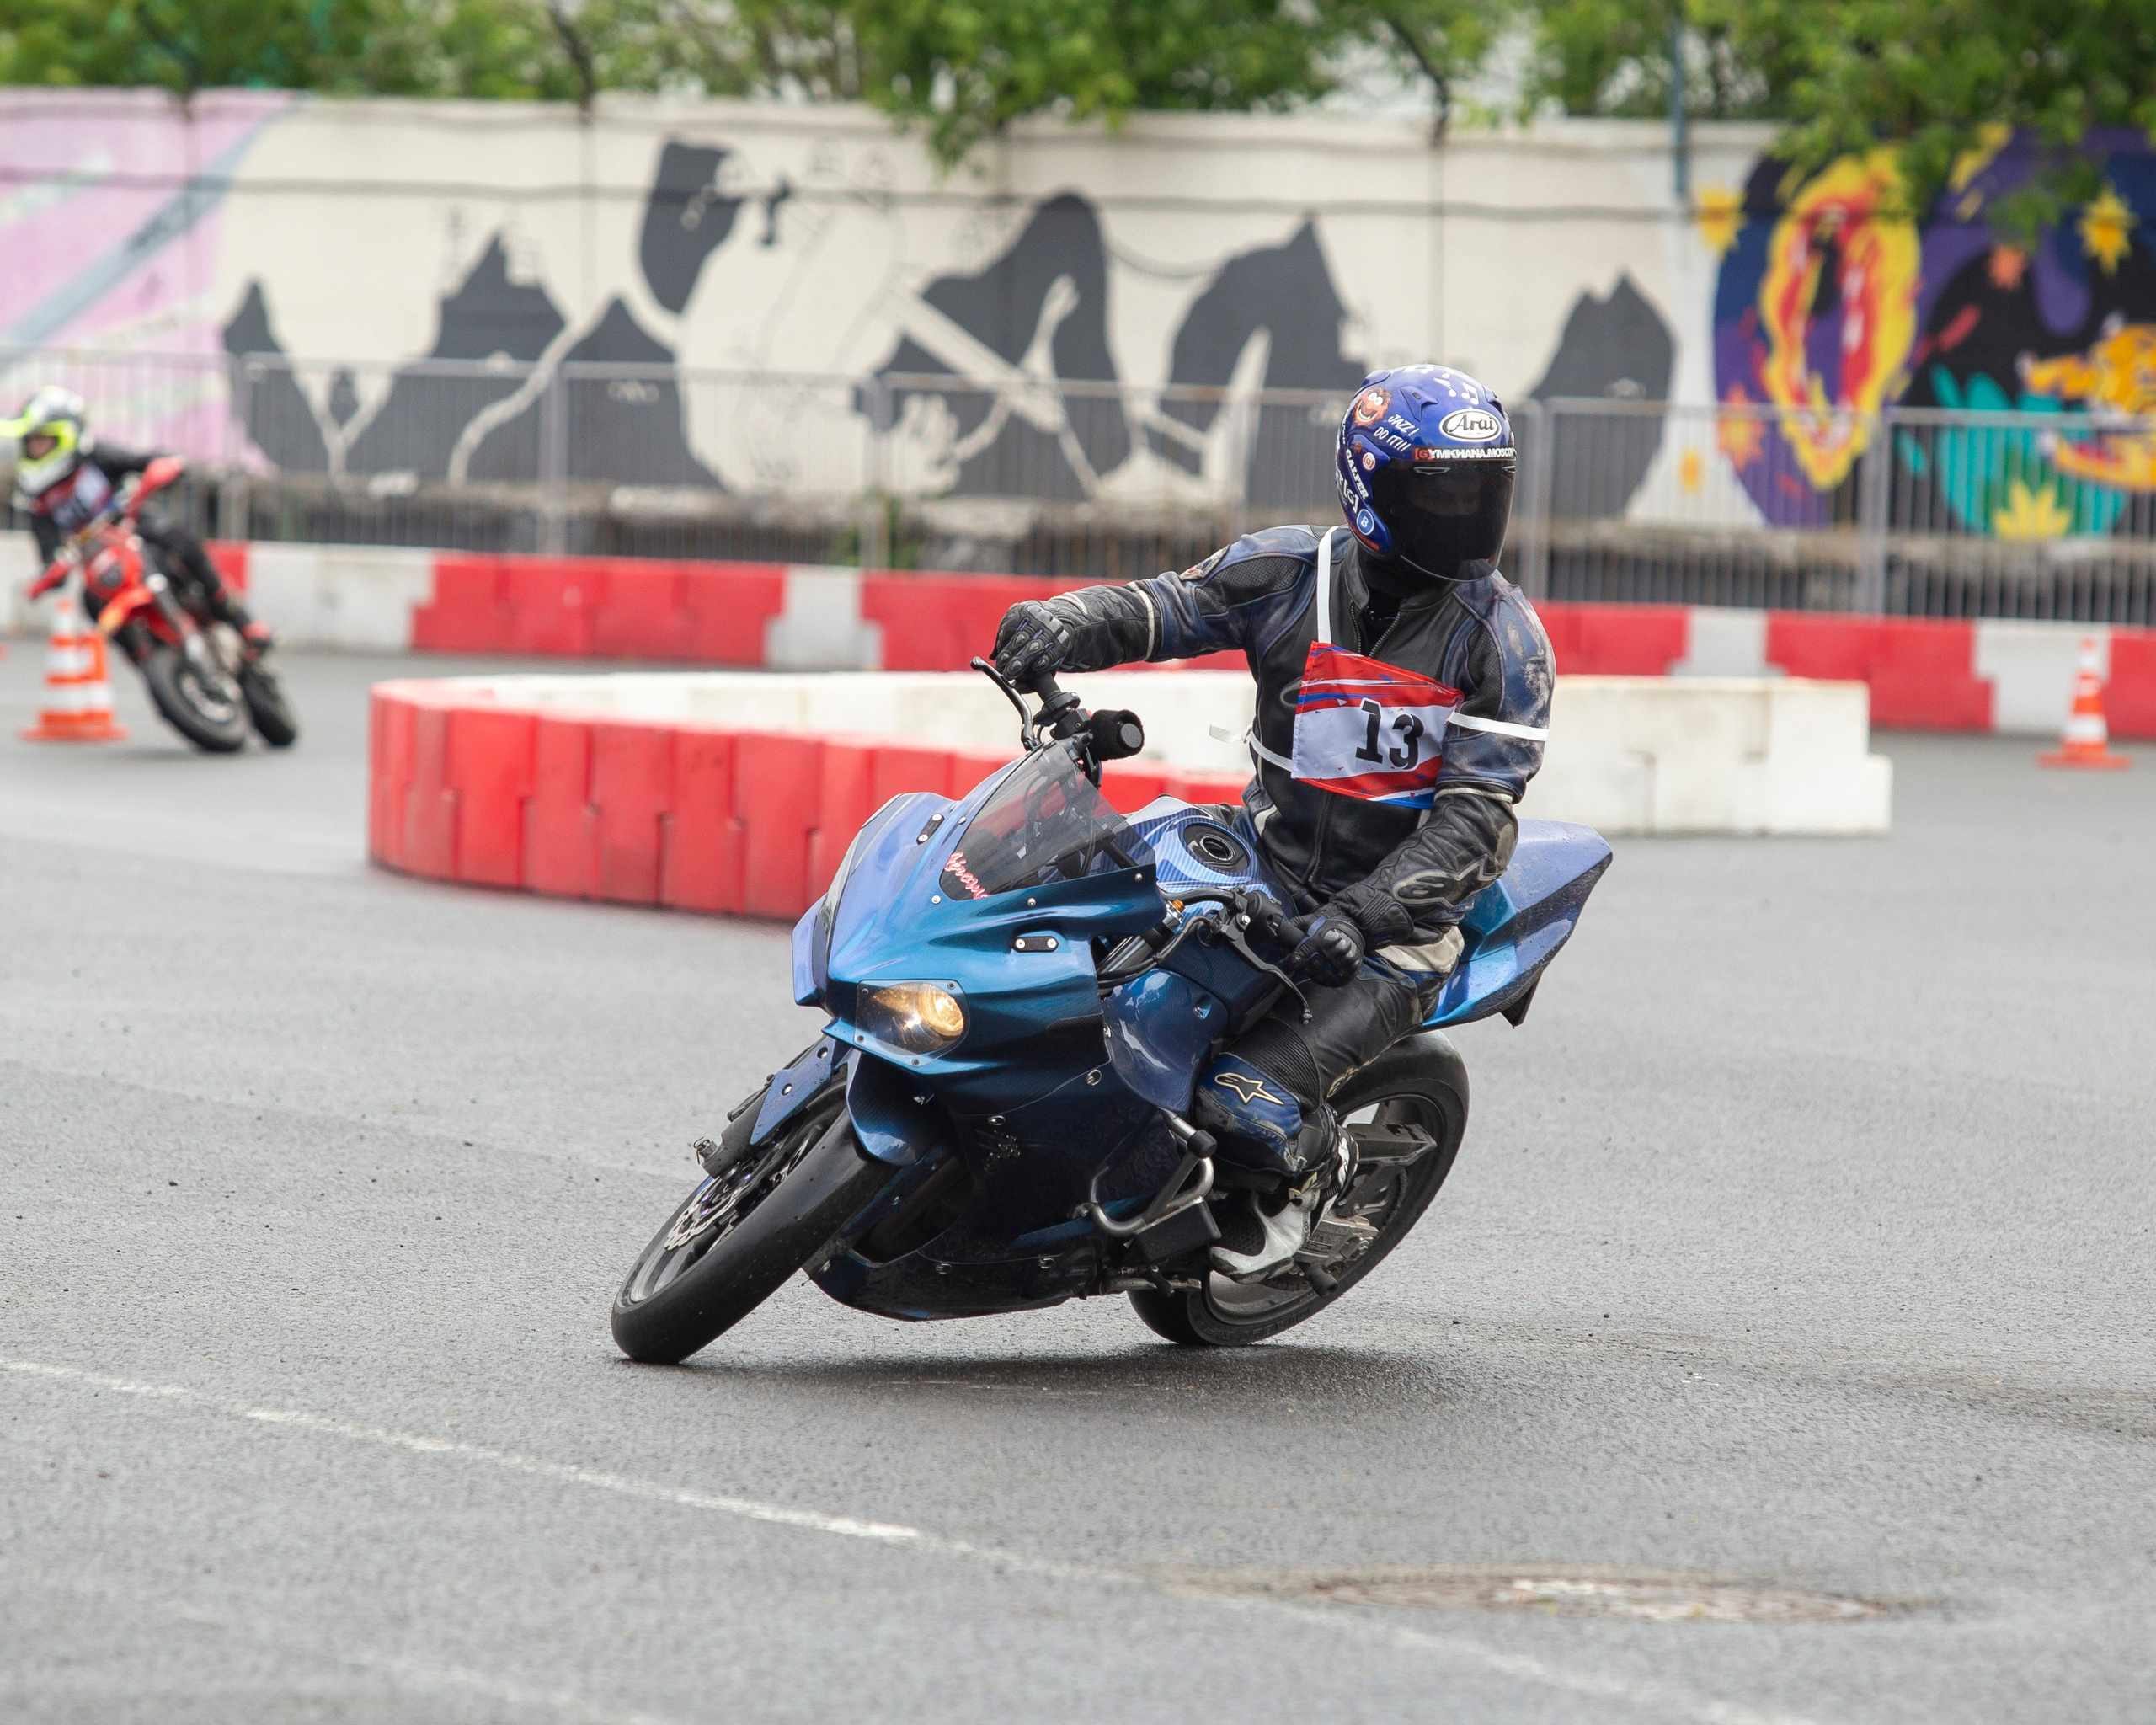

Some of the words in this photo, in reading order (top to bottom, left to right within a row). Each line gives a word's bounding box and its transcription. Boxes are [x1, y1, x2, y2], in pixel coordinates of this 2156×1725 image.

[1374, 426, 1389, 439] DO
[1386, 435, 1412, 452] IT!!!
[1449, 414, 1494, 432] Arai
[1346, 448, 1369, 500] GALFER
[1355, 698, 1425, 770] 13
